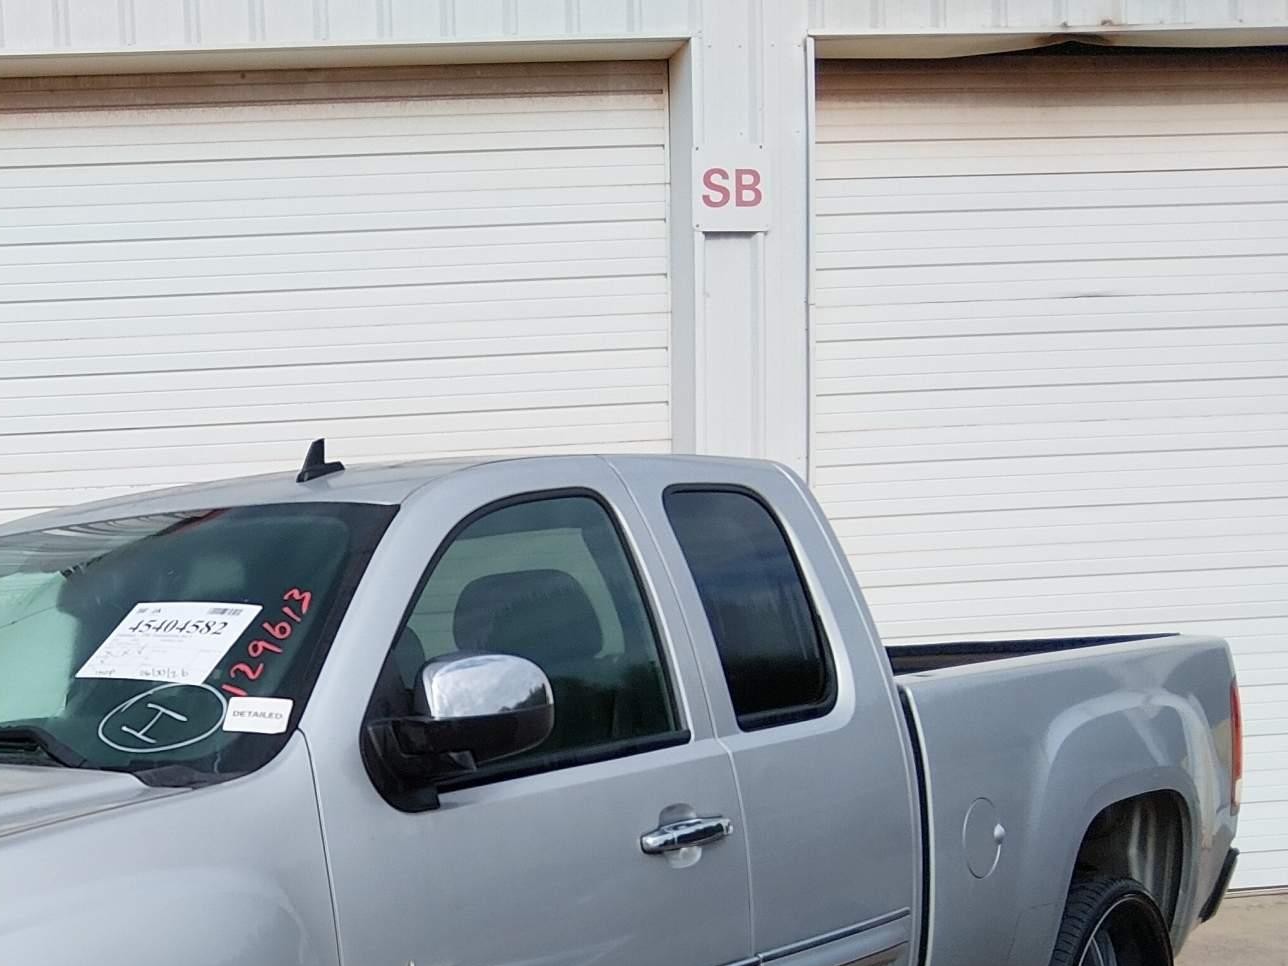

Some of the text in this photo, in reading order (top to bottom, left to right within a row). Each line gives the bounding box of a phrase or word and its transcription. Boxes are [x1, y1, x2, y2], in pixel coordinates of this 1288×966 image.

[702, 168, 762, 208] SB
[129, 619, 228, 635] 45404582
[222, 587, 312, 697] 129613
[232, 710, 283, 720] DETAILED
